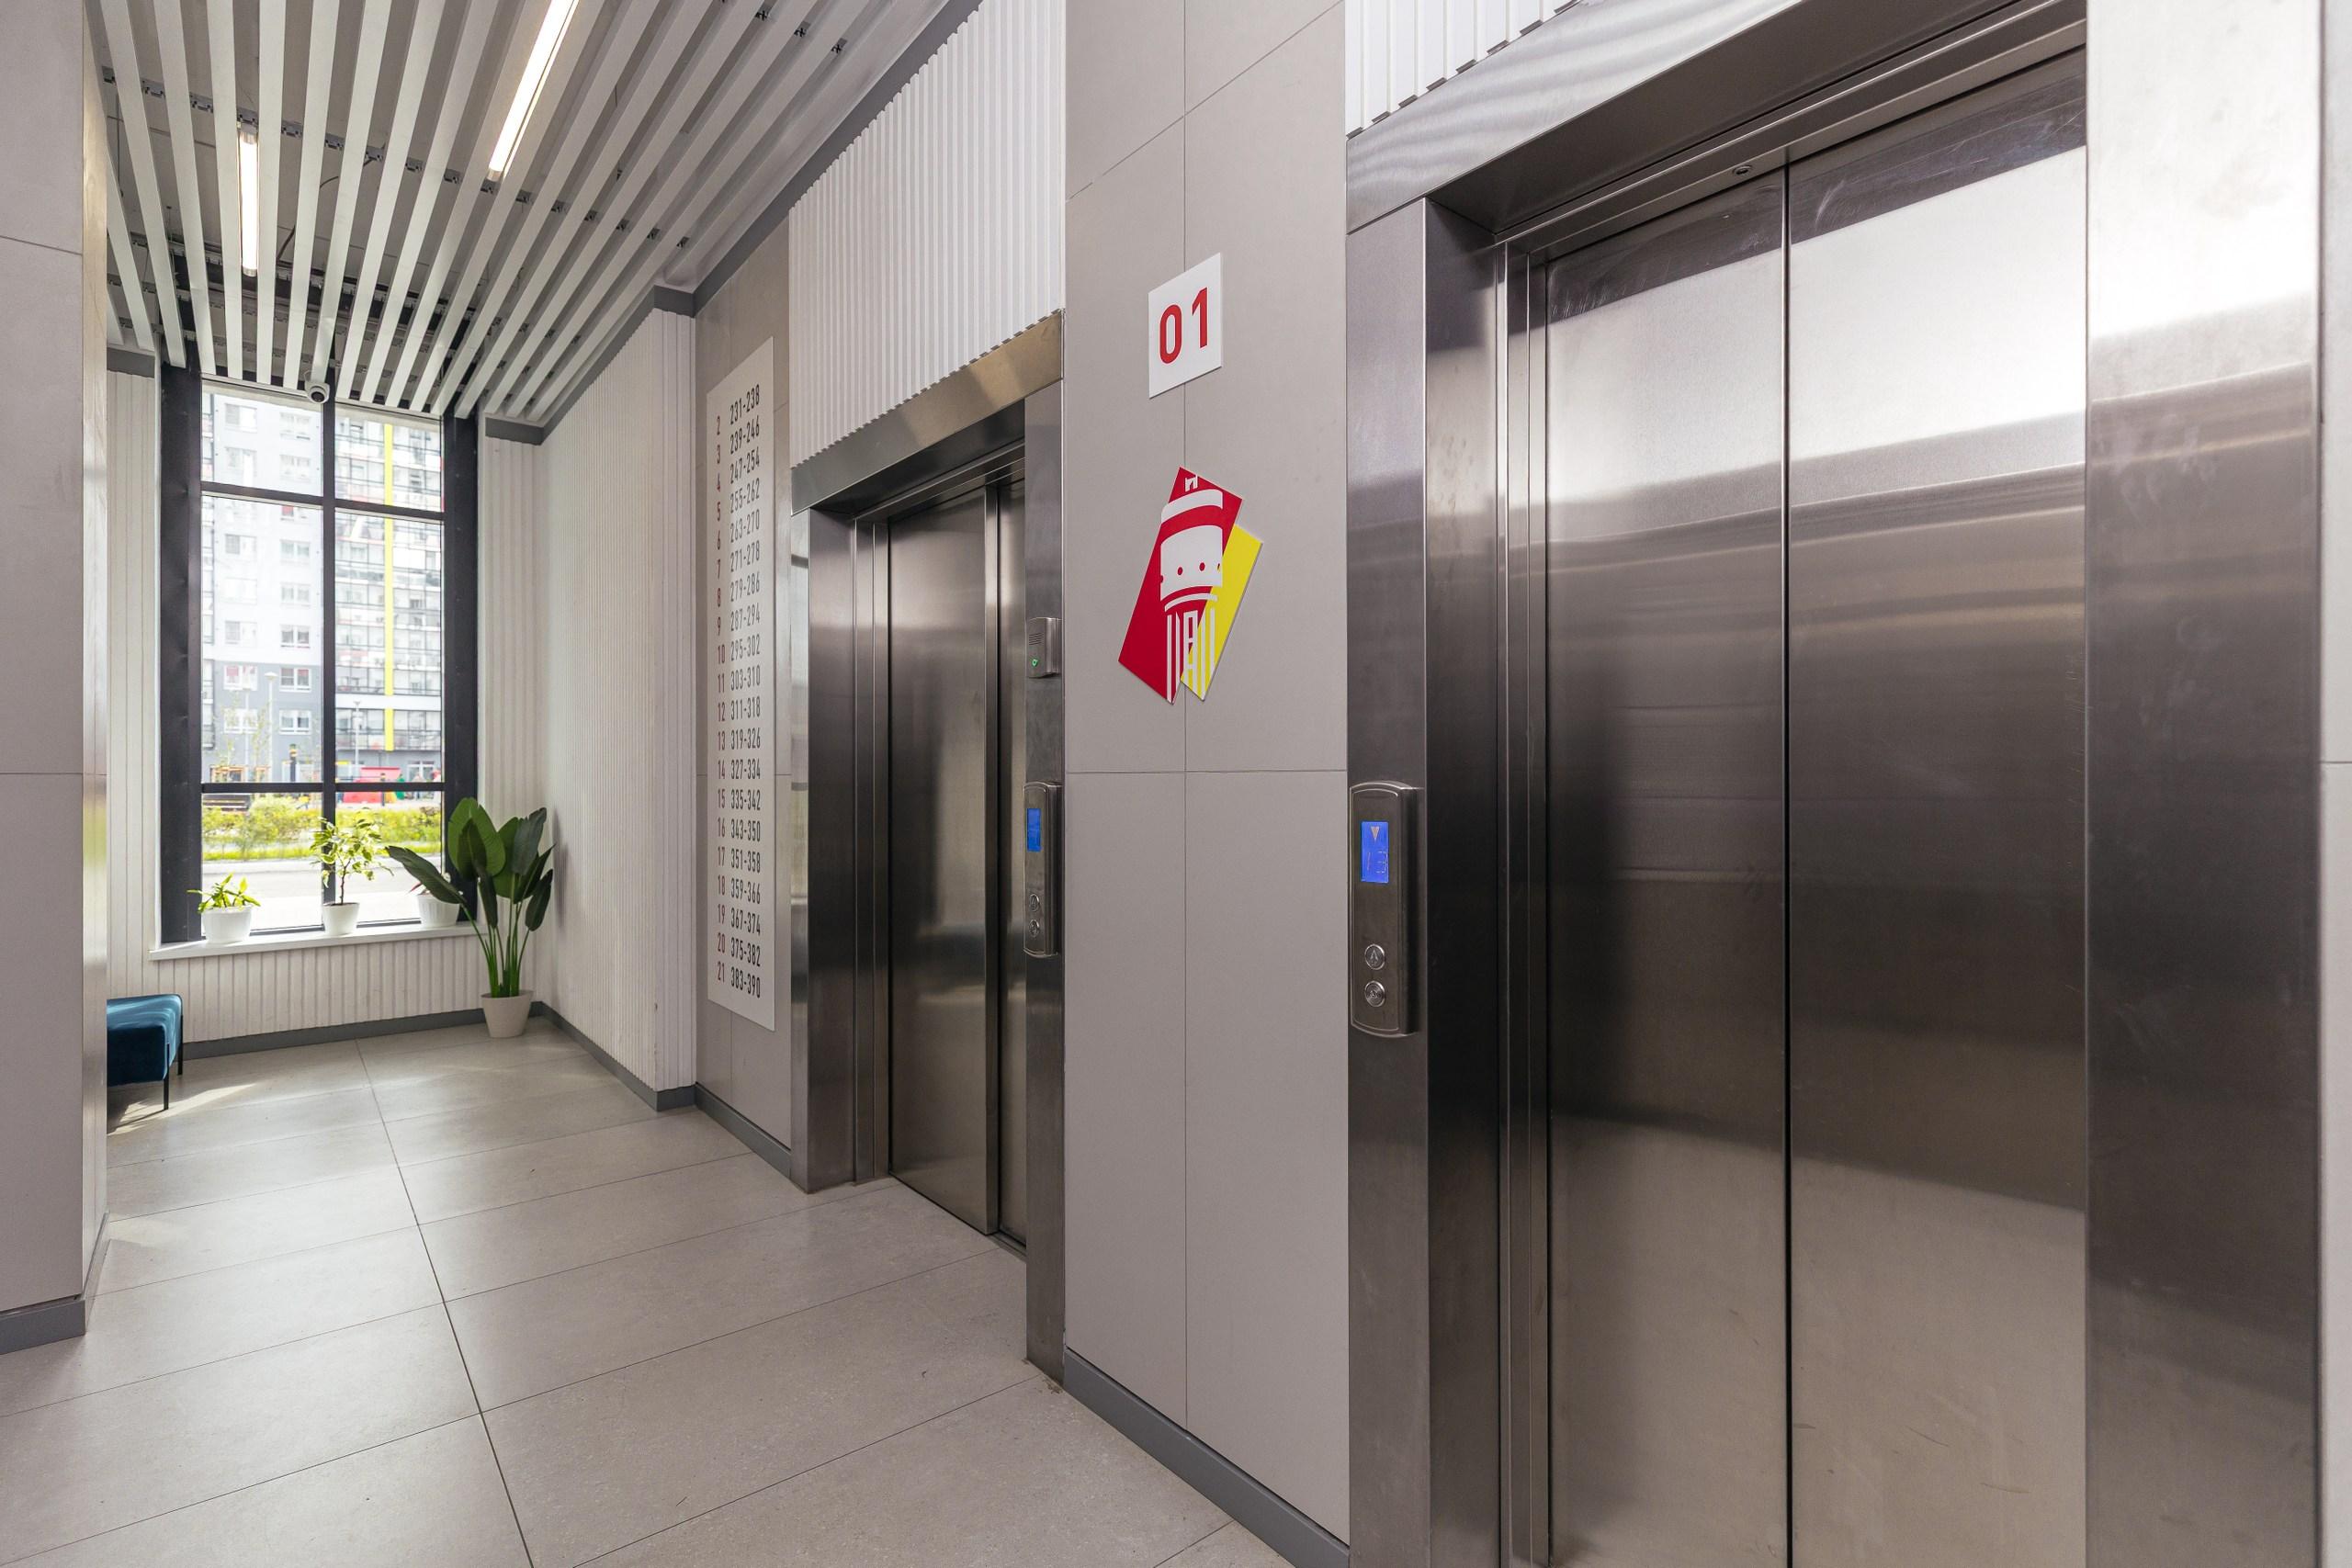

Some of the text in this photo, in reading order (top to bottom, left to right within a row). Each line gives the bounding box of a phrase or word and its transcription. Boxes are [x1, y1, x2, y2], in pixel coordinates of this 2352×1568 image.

[1159, 287, 1208, 365] 01
[717, 384, 761, 436] 2 231-238
[717, 414, 761, 465] 3 239-246
[717, 446, 761, 493] 4 247-254
[717, 477, 761, 522] 5 255-262
[717, 508, 761, 551] 6 263-270
[717, 539, 761, 580] 7 271-278
[717, 570, 761, 608] 8 279-286
[717, 603, 761, 637] 9 287-294
[717, 634, 761, 665] 10 295-302
[717, 664, 761, 694] 11 303-310
[717, 695, 761, 722] 12 311-318
[717, 727, 761, 751] 13 319-326
[717, 758, 761, 780] 14 327-334
[717, 788, 761, 811] 15 335-342
[717, 818, 761, 842] 16 343-350
[717, 846, 761, 874] 17 351-358
[717, 874, 761, 905] 18 359-366
[717, 904, 761, 936] 19 367-374
[717, 931, 761, 967] 20 375-382
[717, 961, 761, 998] 21 383-390
